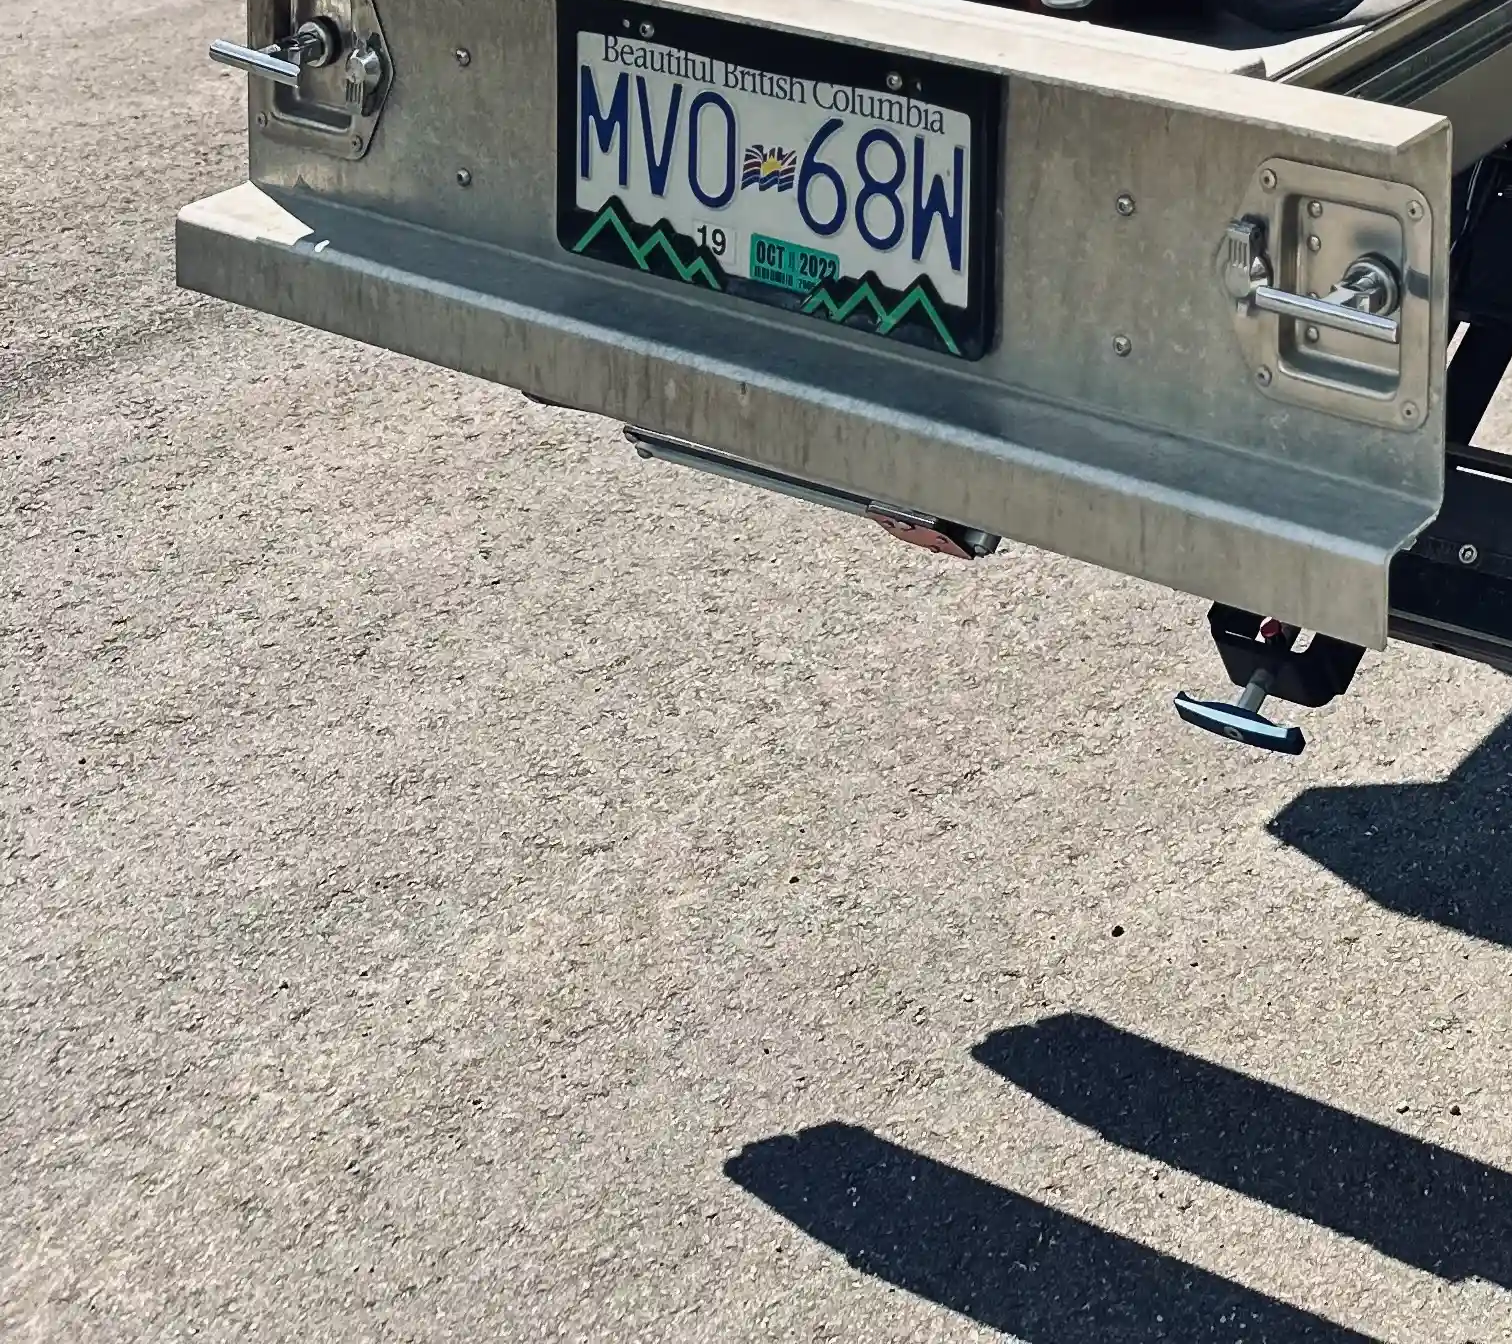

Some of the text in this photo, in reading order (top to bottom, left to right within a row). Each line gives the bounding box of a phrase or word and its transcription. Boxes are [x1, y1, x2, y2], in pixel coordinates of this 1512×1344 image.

[602, 35, 945, 134] Beautiful British Columbia
[580, 64, 965, 272] MVO 68W
[697, 224, 727, 256] 19
[756, 240, 785, 271] OCT
[800, 252, 838, 279] 2022
